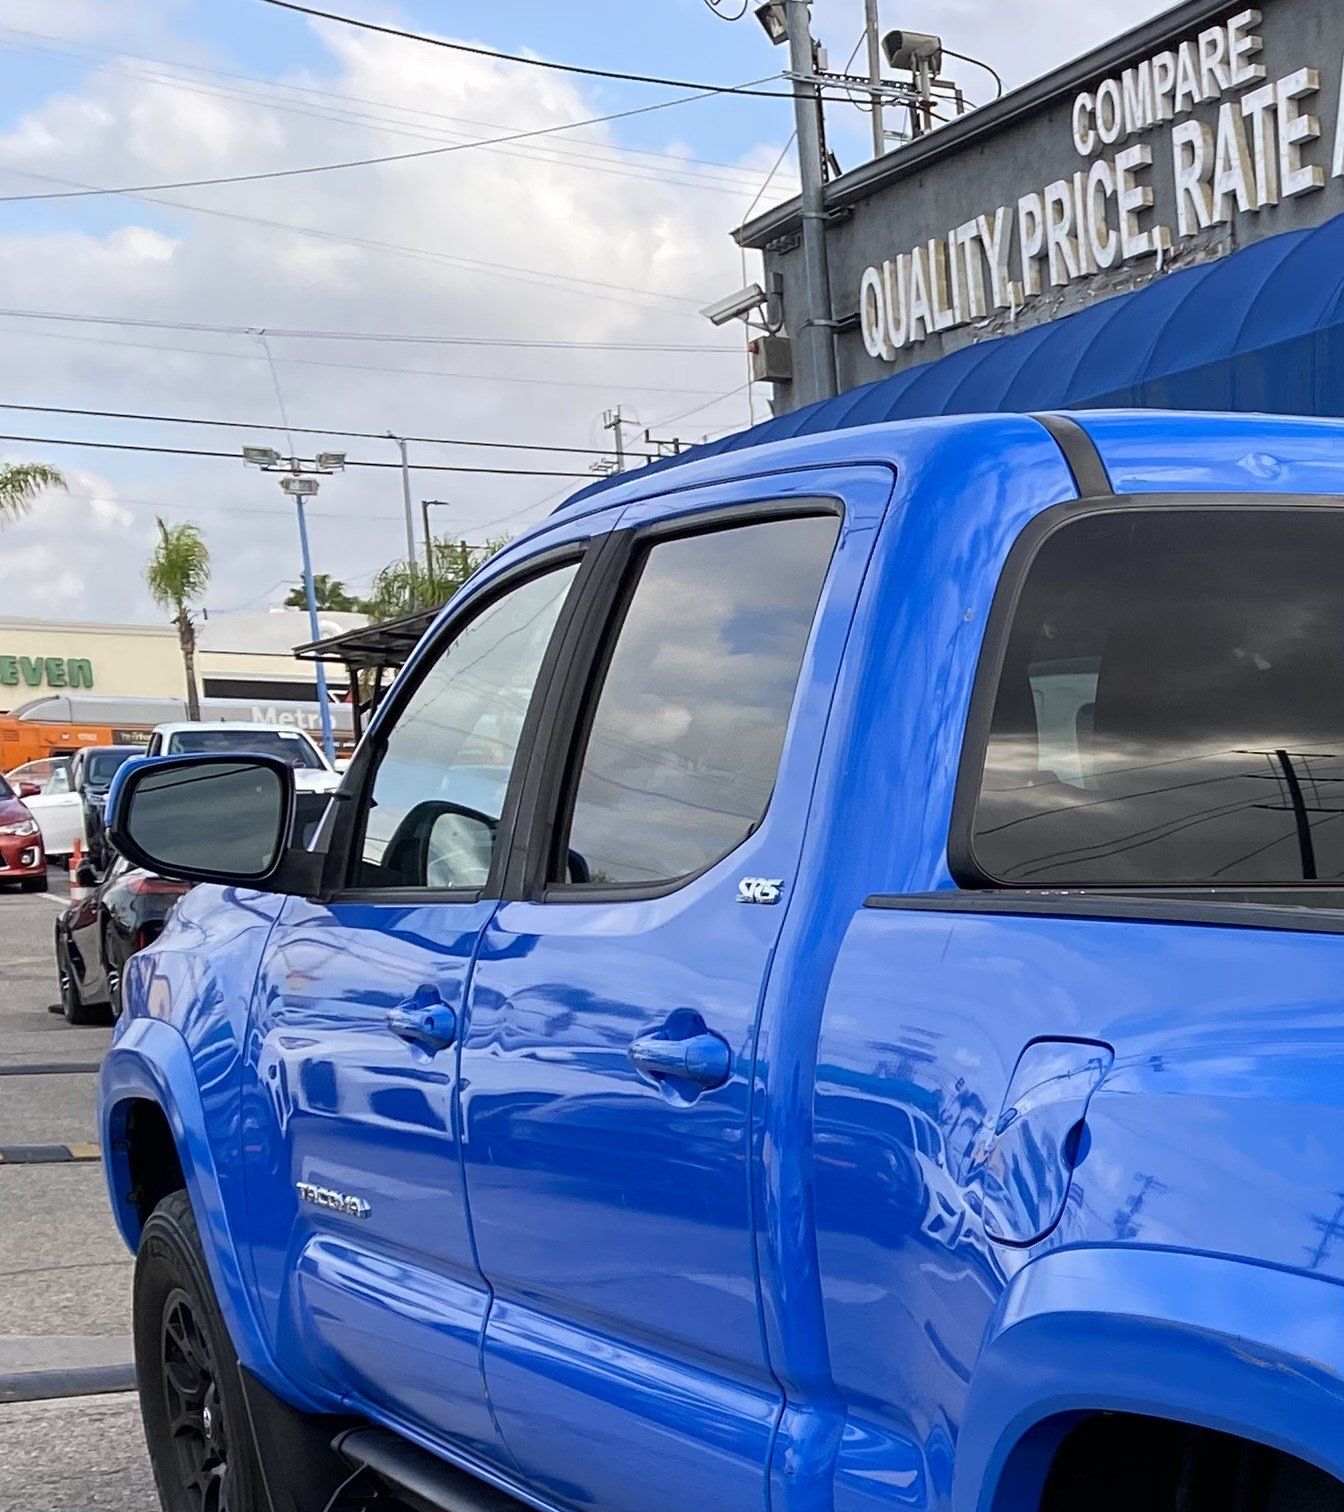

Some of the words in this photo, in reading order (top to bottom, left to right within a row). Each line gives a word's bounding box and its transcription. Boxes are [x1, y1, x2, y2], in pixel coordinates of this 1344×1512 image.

[1072, 9, 1267, 157] COMPARE
[1172, 67, 1325, 237] RATE
[296, 1181, 373, 1219] TACOMA
